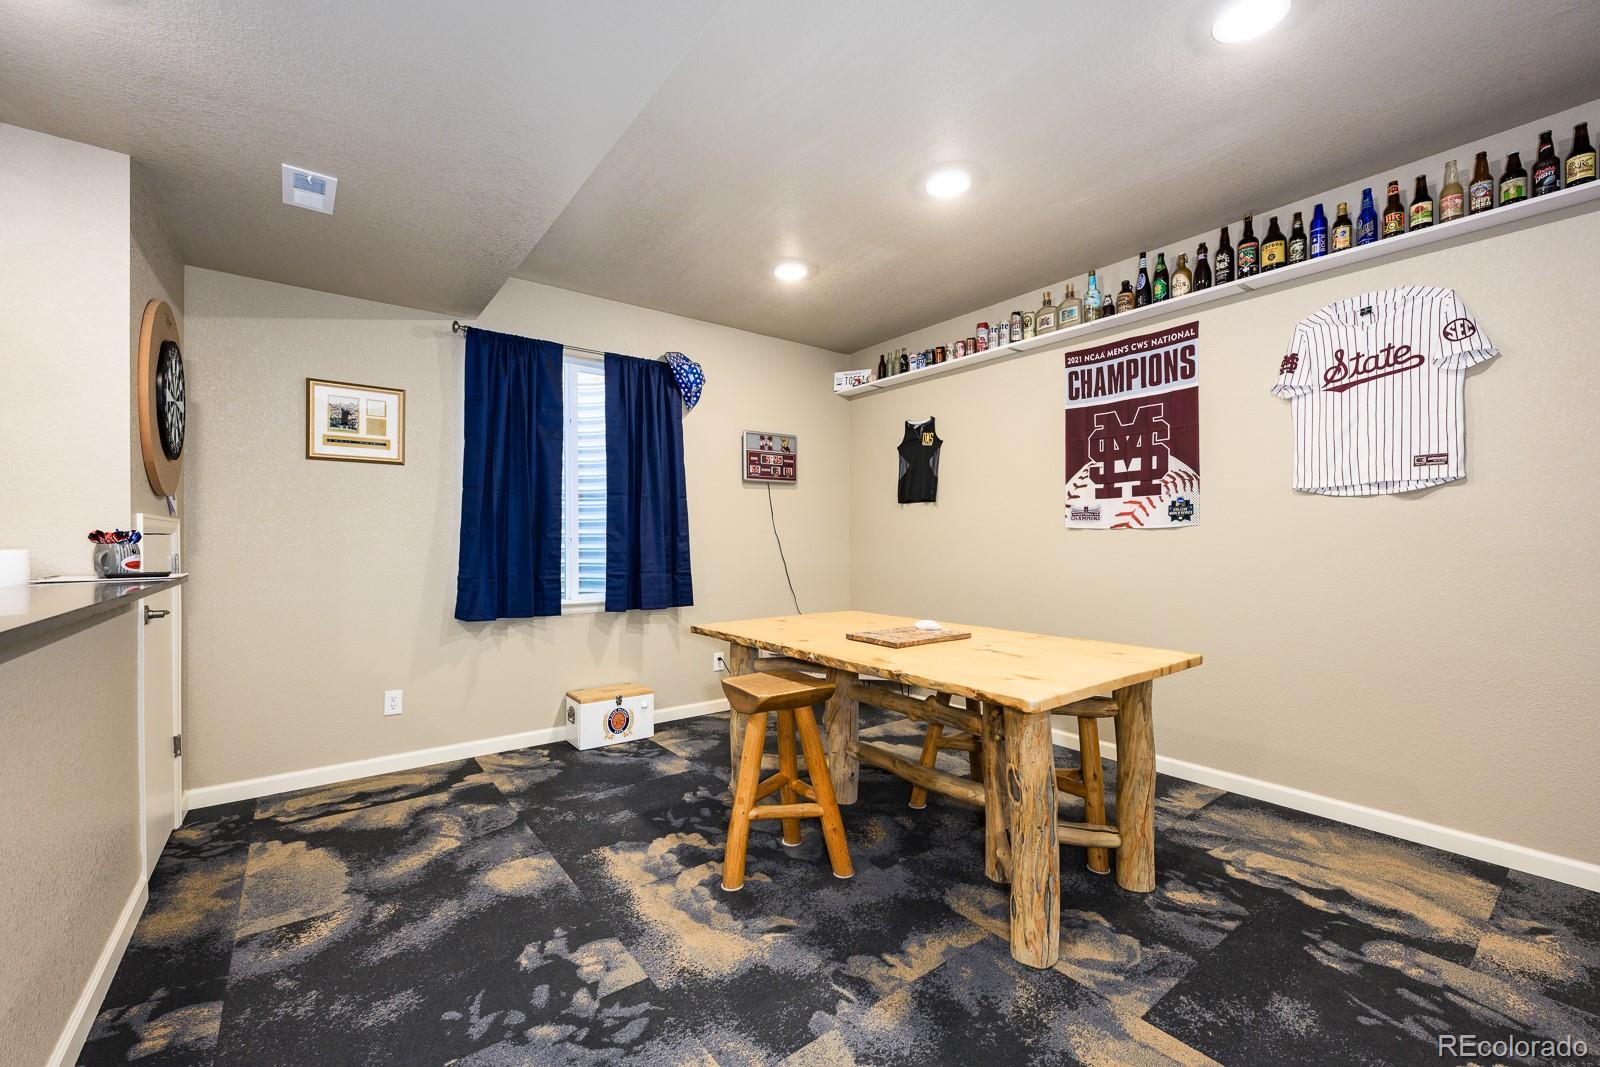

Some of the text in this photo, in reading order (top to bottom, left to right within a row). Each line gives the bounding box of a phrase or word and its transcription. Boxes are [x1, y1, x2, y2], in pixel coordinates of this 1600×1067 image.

[1067, 328, 1196, 364] 2021 NCAA MEN'S CWS NATIONAL
[1445, 319, 1474, 341] SEC
[1068, 344, 1196, 401] CHAMPIONS
[1321, 342, 1425, 393] State
